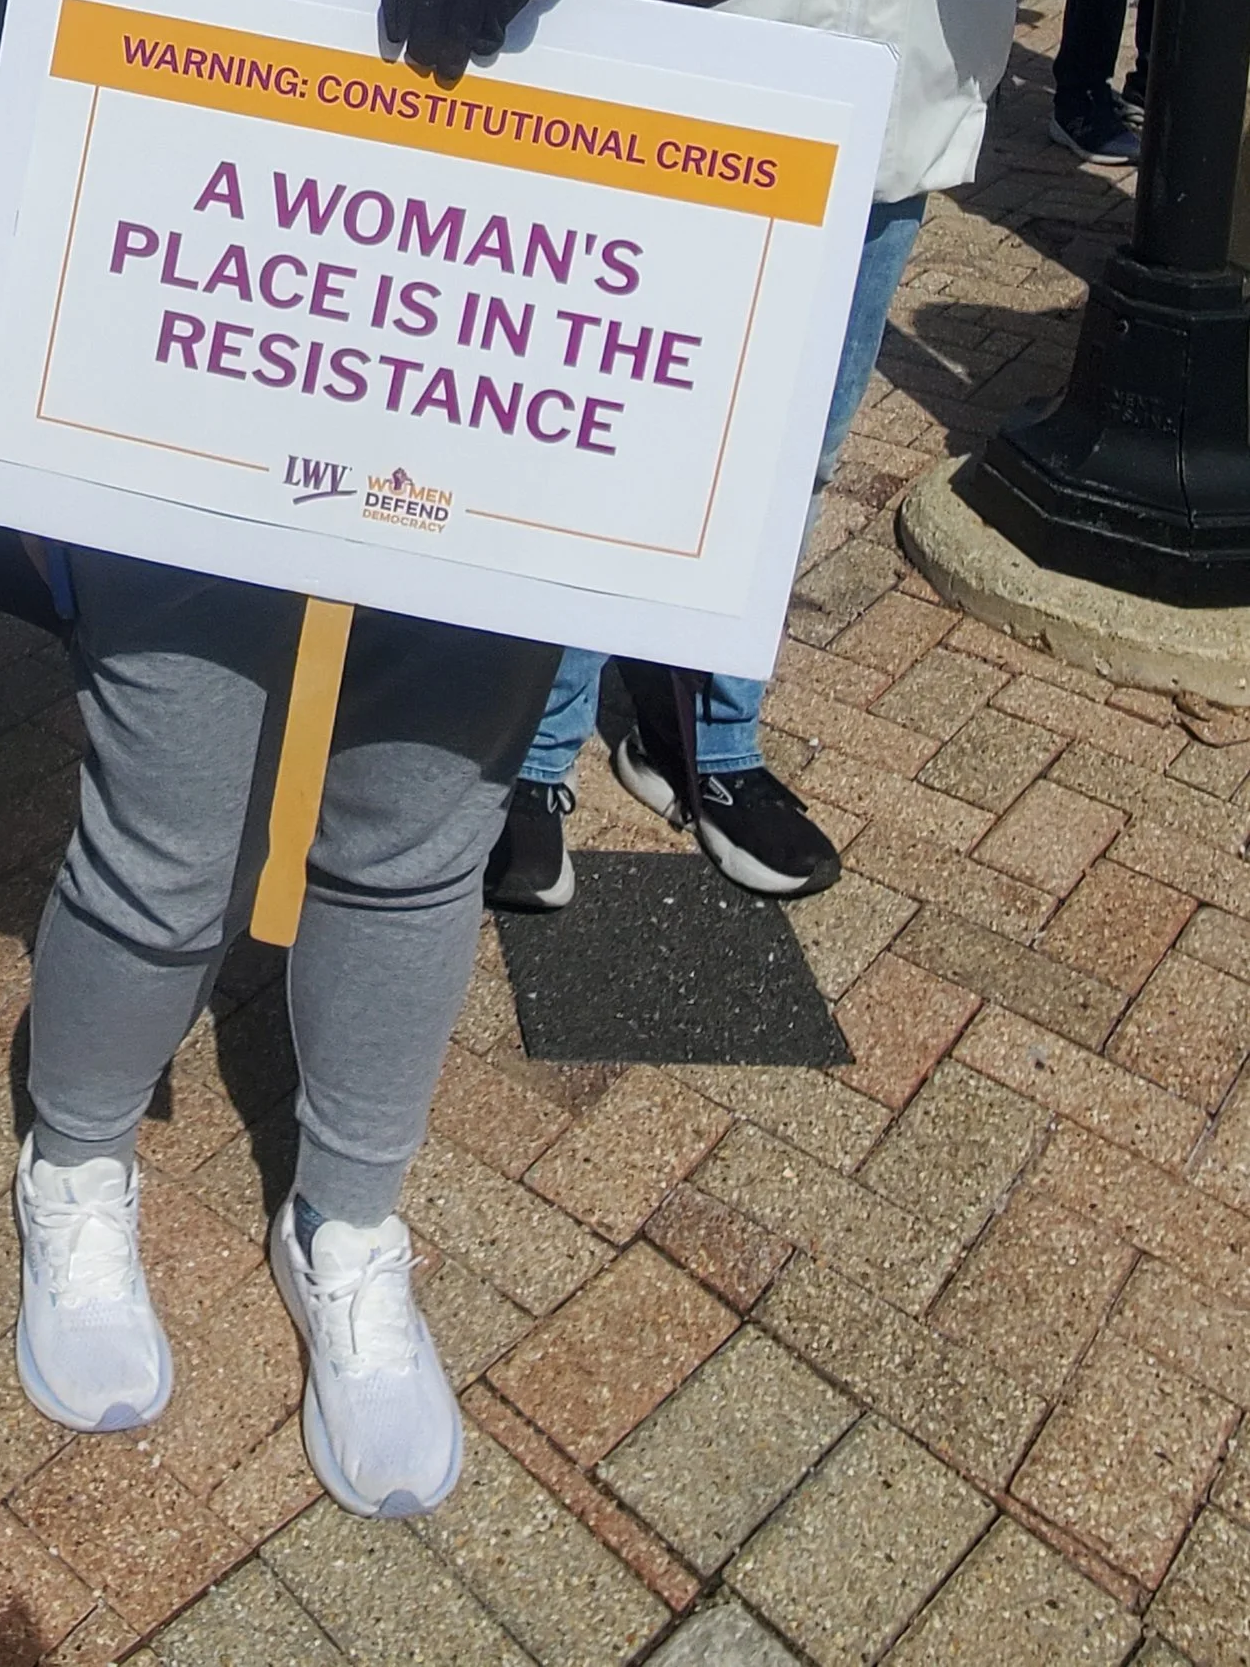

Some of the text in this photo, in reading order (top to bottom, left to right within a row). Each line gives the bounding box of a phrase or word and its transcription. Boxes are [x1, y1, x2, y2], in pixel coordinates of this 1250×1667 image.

[123, 35, 778, 188] WARNING: CONSTITUTIONAL CRISIS
[194, 161, 642, 295] A WOMAN'S
[109, 220, 703, 391] PLACE IS IN THE
[156, 311, 625, 455] RESISTANCE
[282, 454, 349, 494] LWV
[362, 507, 446, 533] DEMOCRACY
[364, 491, 450, 522] DEFEND
